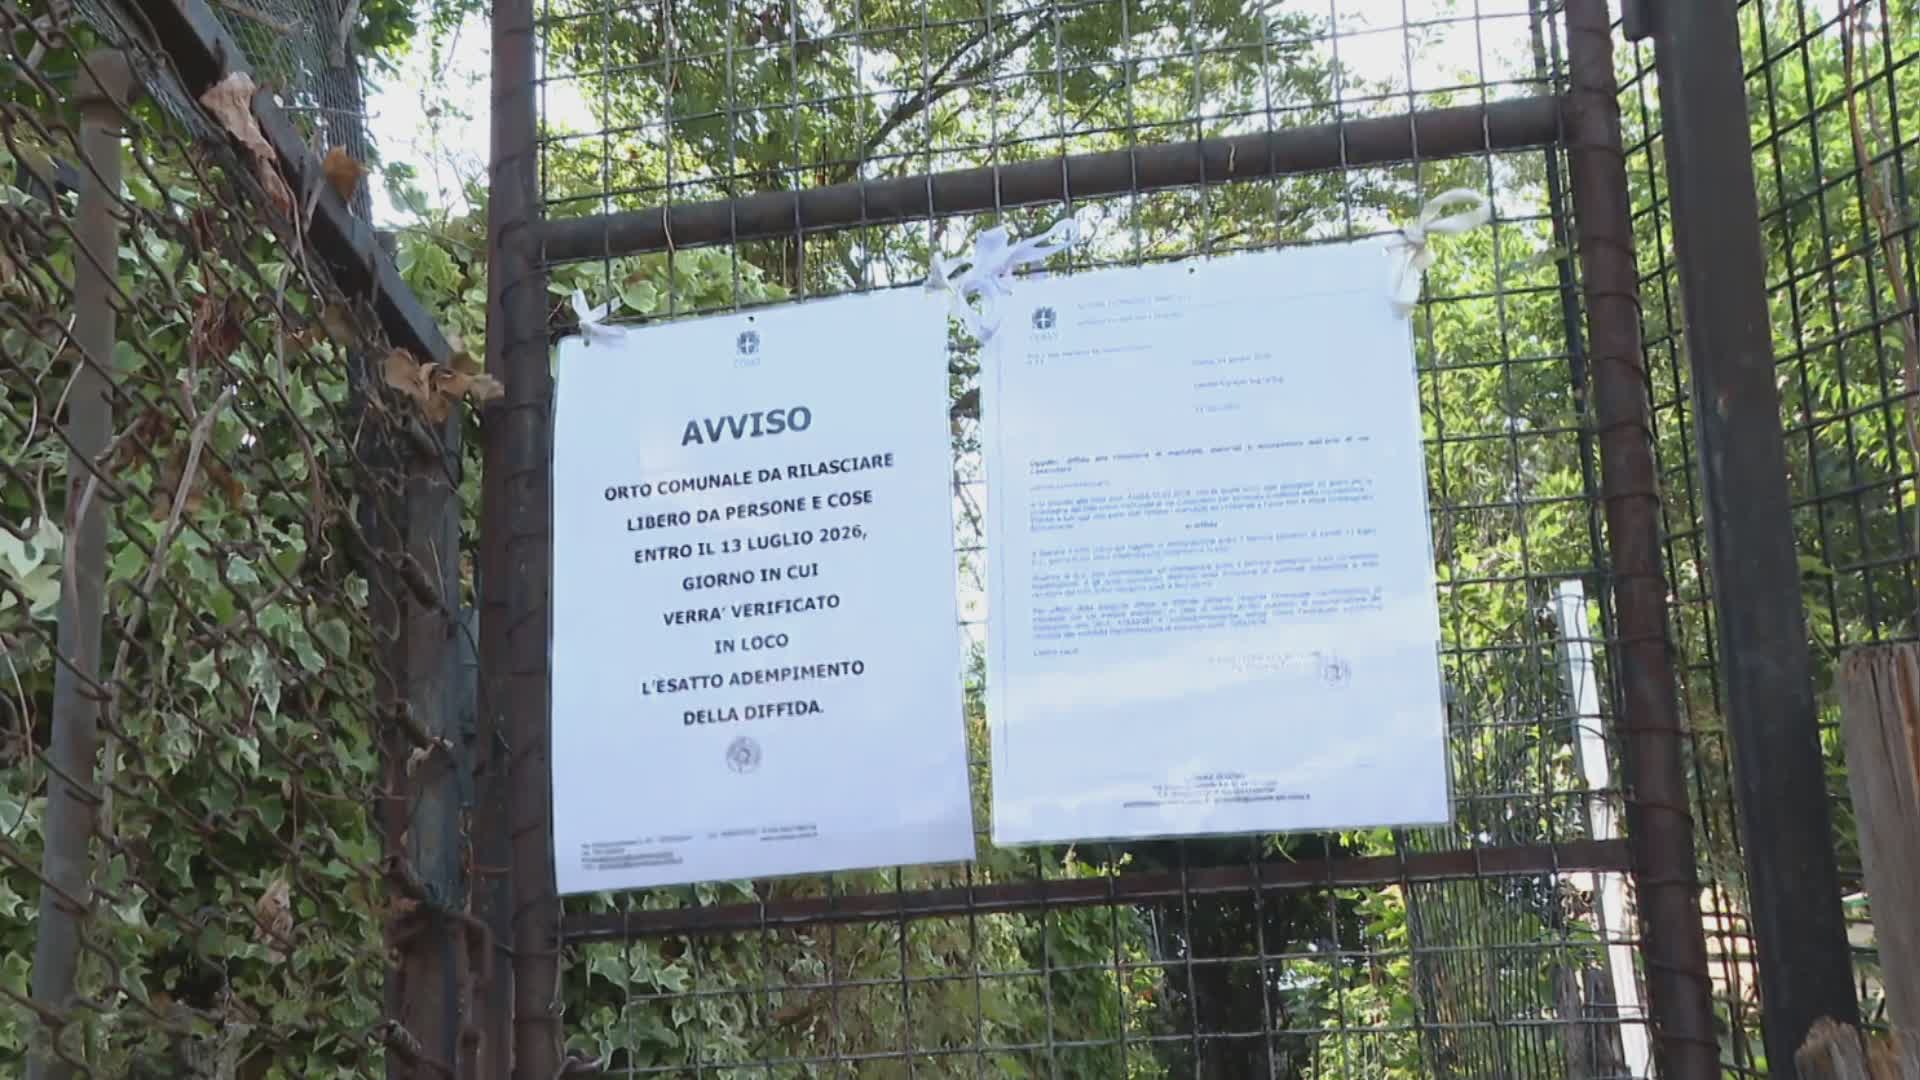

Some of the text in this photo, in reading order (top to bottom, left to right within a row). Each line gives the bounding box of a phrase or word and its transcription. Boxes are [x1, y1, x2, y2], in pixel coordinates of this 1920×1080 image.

[681, 405, 812, 447] AVVISO
[604, 452, 894, 502] ORTO COMUNALE DA RILASCIARE
[626, 489, 873, 532] LIBERO DA PERSONE E COSE
[634, 524, 868, 565] ENTRO IL 13 LUGLIO 2026,
[681, 562, 819, 592] GIORNO IN CUI
[730, 593, 841, 619] VERIFICATO
[714, 632, 790, 655] IN LOCO
[641, 659, 865, 696] L'ESATTO ADEMPIMENTO
[683, 699, 825, 727] DELLA DIFFIDA.
